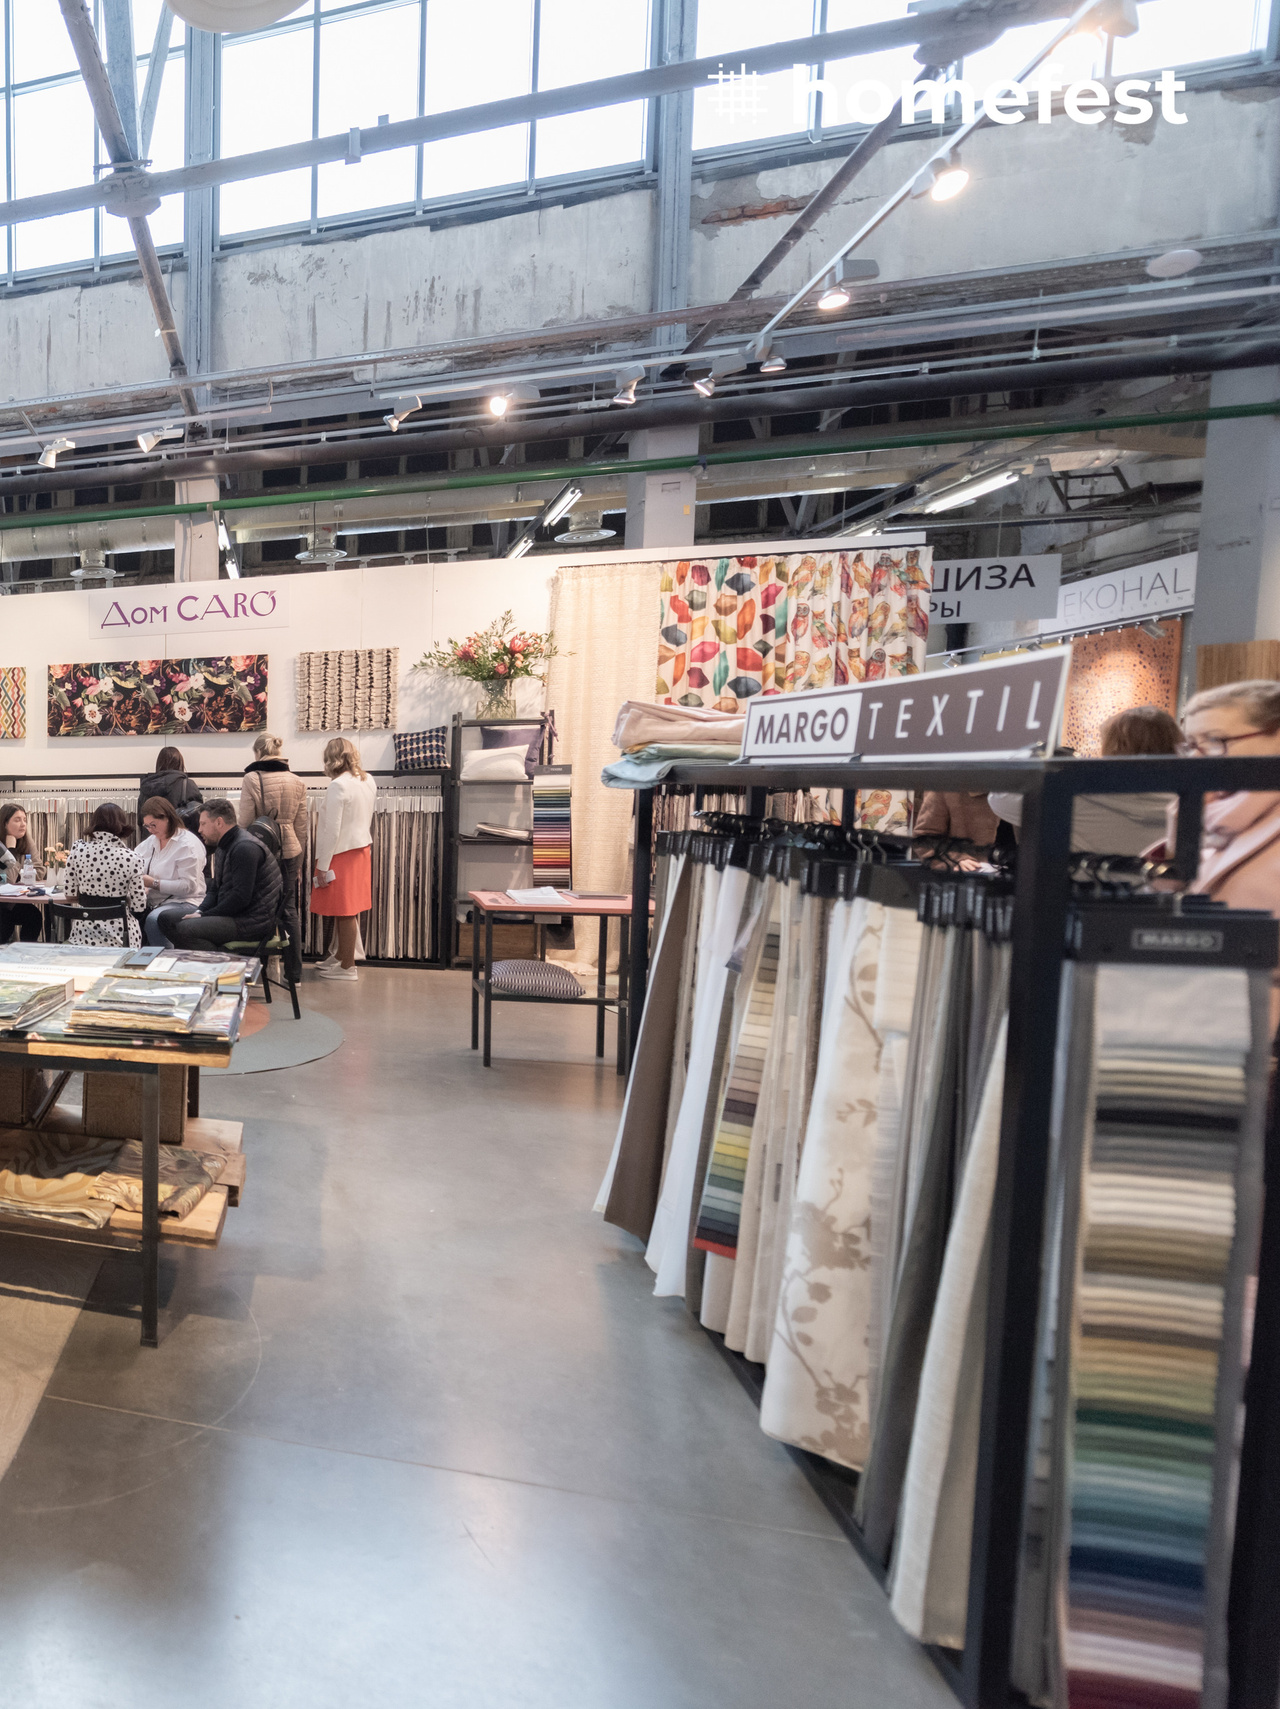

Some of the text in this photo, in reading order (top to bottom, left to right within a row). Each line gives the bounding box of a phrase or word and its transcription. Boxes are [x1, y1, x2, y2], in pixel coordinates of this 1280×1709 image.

[100, 601, 167, 629] Дом
[754, 681, 1041, 744] MARGO TEXTIL
